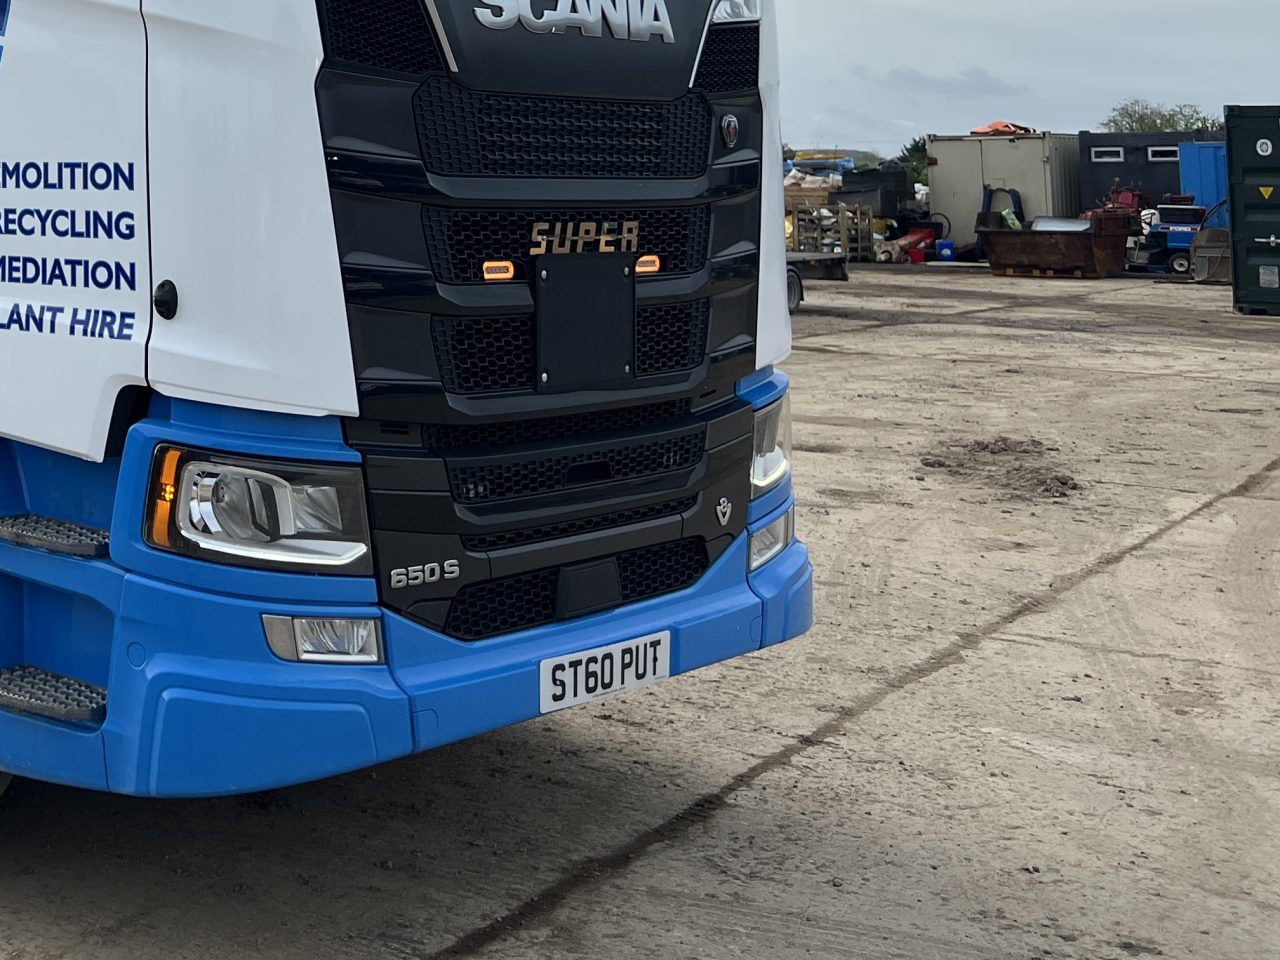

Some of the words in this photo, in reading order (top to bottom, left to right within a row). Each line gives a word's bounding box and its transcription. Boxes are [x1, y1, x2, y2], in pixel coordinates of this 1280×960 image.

[530, 221, 639, 255] SUPER
[69, 307, 136, 341] HIRE
[391, 562, 440, 588] 650
[444, 559, 460, 579] S
[552, 652, 614, 702] ST60
[620, 639, 661, 685] PUT
